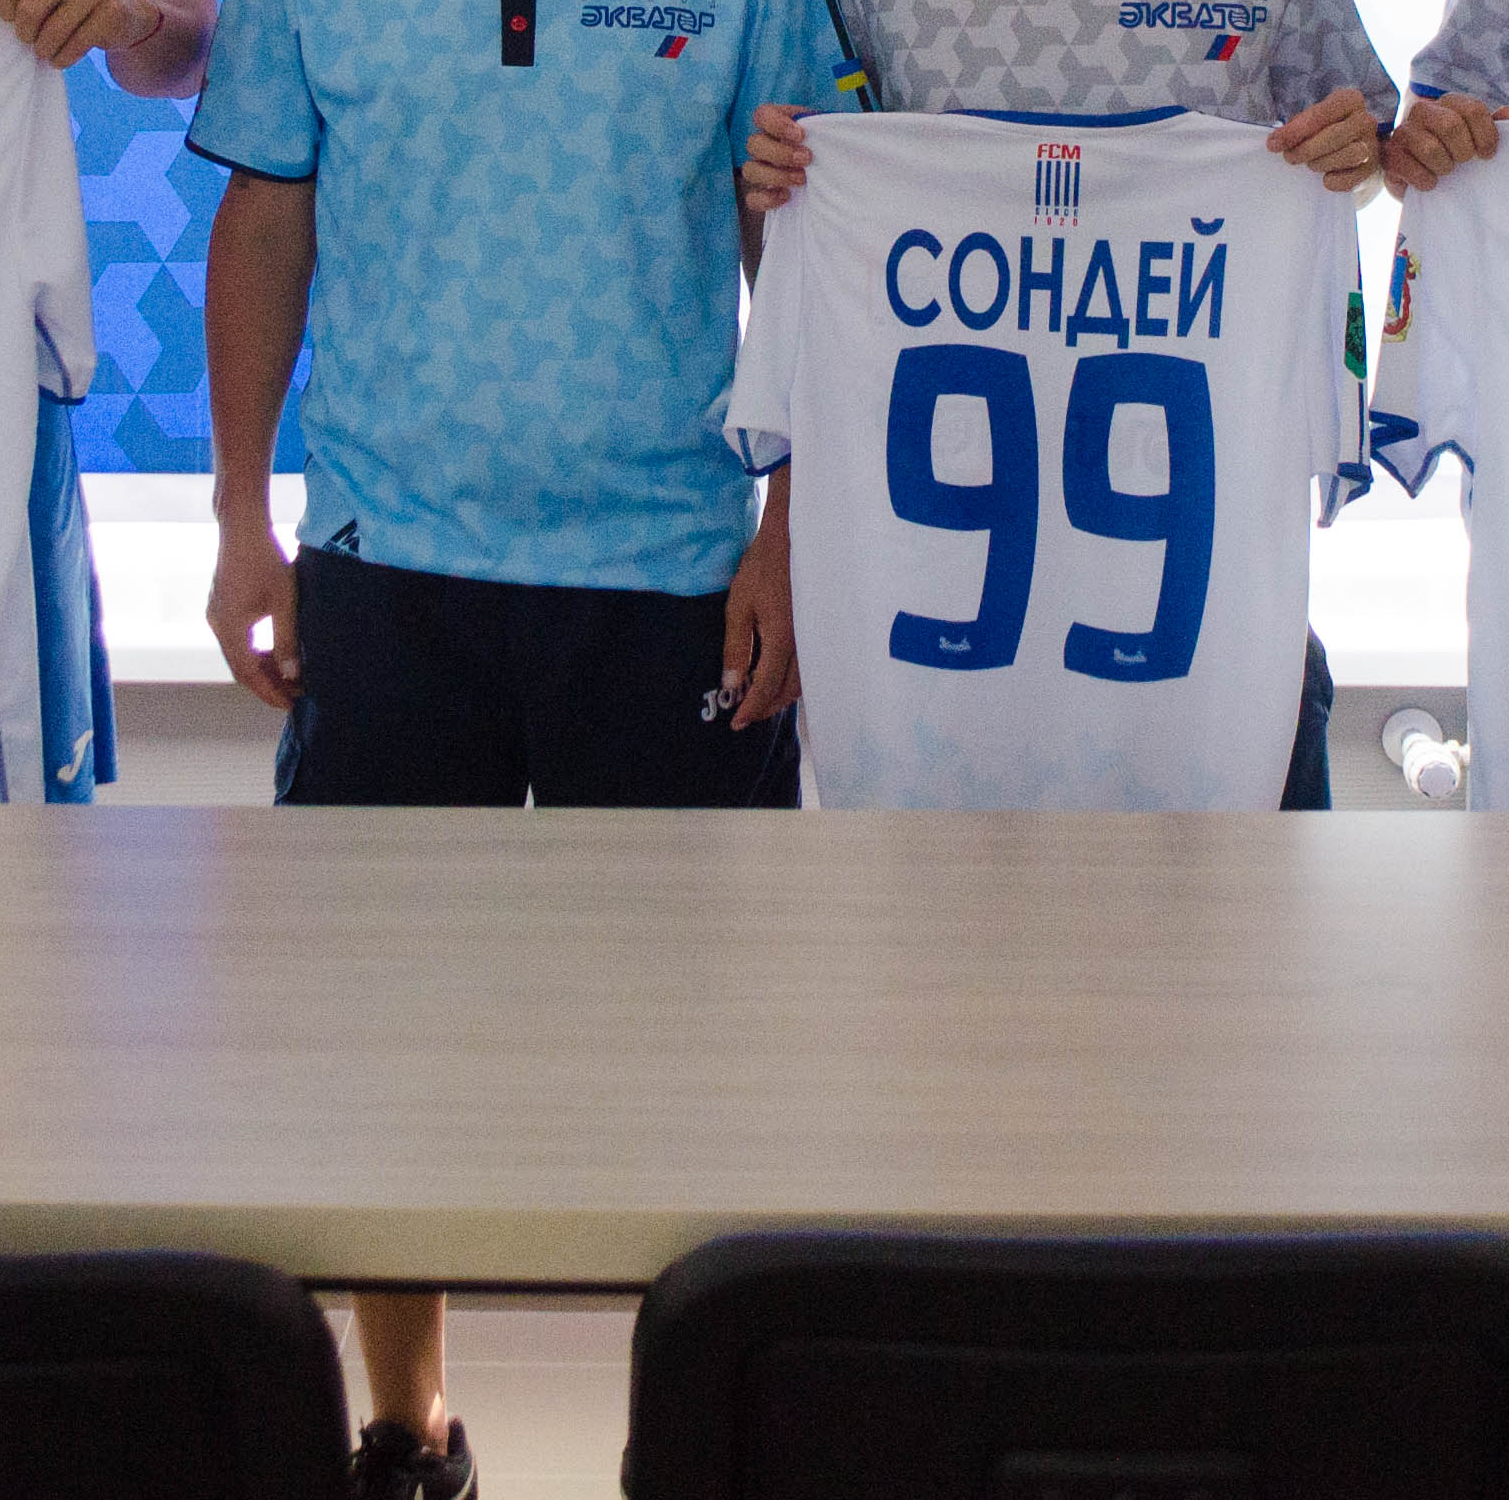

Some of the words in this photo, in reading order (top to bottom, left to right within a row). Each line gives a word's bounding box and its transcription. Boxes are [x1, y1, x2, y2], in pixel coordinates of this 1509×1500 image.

[580, 5, 716, 35] ЭКВАТОР
[1118, 2, 1268, 32] ЭКВАТОР
[1037, 143, 1082, 160] FCM
[885, 217, 1228, 349] СОНДЕЙ
[886, 343, 1217, 683] 99
